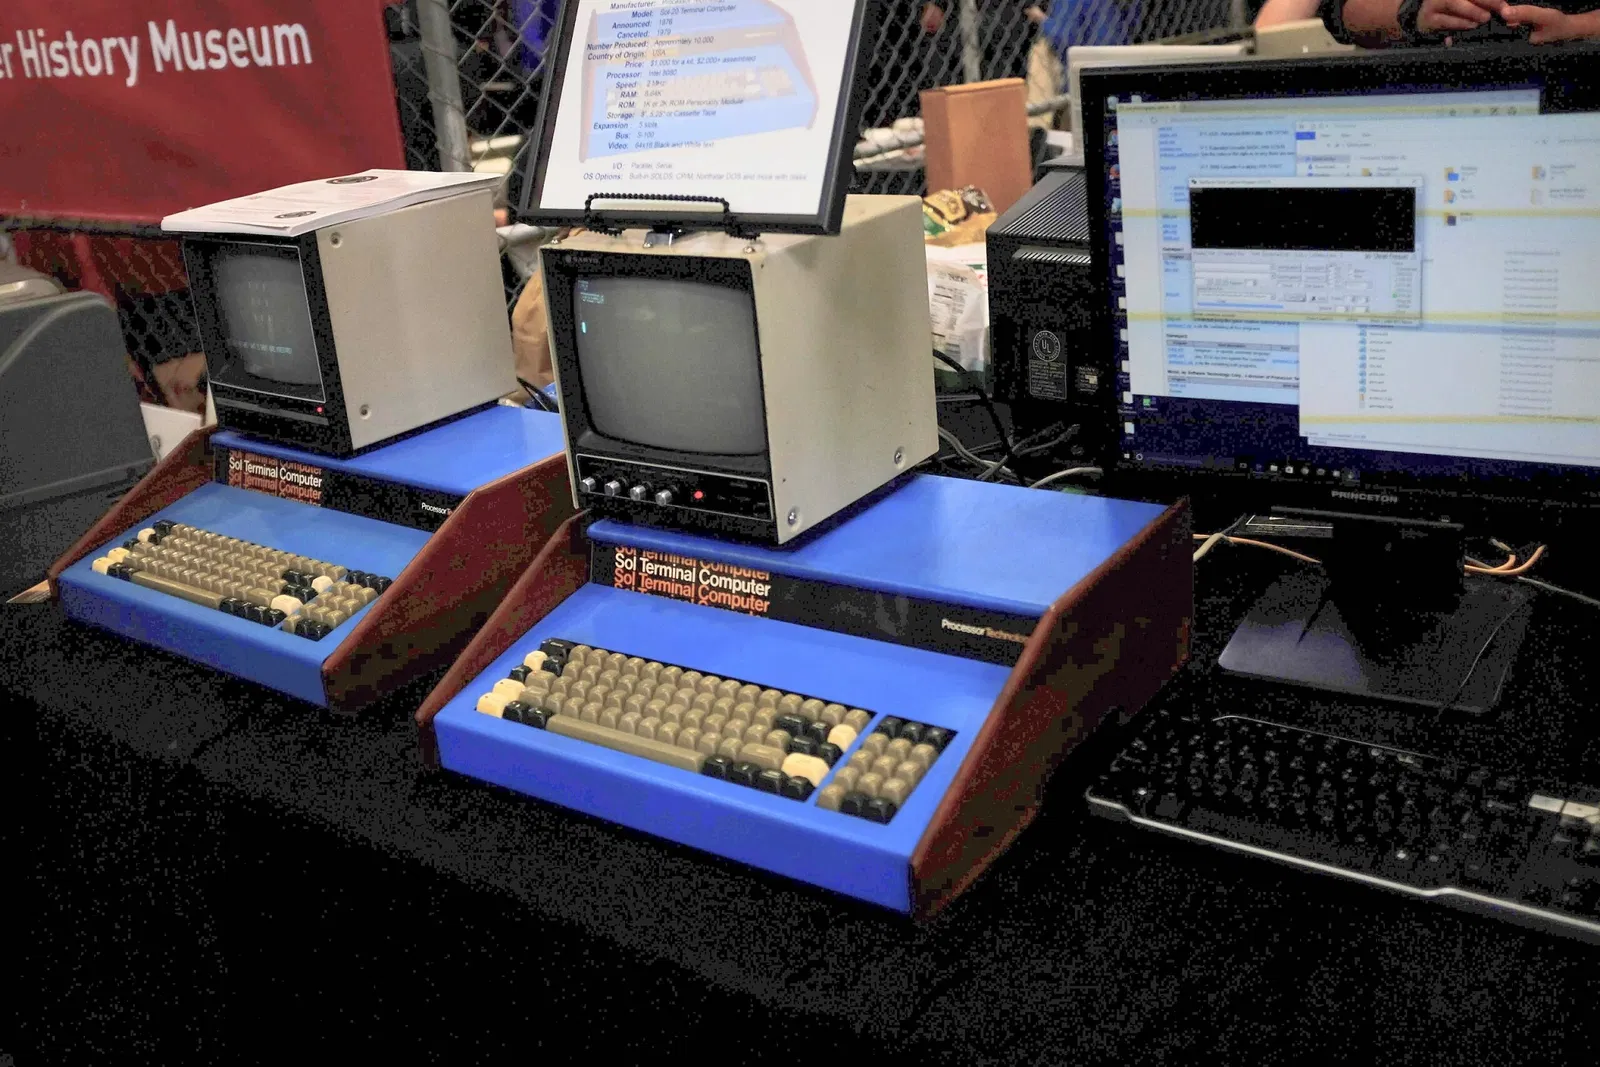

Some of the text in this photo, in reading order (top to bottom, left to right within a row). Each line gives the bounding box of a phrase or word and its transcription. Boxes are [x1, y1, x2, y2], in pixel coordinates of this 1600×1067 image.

[631, 10, 654, 19] Model:
[706, 4, 737, 12] Computer
[612, 20, 652, 30] Announced:
[616, 31, 650, 40] Canceled:
[586, 43, 613, 51] Number
[613, 40, 649, 49] Produced:
[16, 28, 139, 88] History
[147, 19, 313, 73] Museum
[587, 51, 614, 62] Country
[617, 51, 626, 60] of
[652, 49, 667, 58] USA
[624, 61, 645, 69] Price:
[606, 71, 643, 80] Processor:
[606, 111, 636, 121] Storage:
[673, 108, 700, 116] Cassette
[702, 107, 717, 117] Tape
[615, 132, 632, 140] Bus:
[608, 142, 629, 150] Video:
[583, 173, 594, 181] OS
[594, 172, 624, 183] Options:
[228, 457, 323, 488] Sol Terminal Computer
[279, 480, 322, 500] Computer
[1331, 490, 1399, 503] PRINCETON
[421, 502, 447, 514] Processor
[614, 552, 772, 597] Sol Terminal Computer
[614, 567, 636, 586] Sol
[638, 572, 695, 598] Terminal
[697, 583, 771, 613] Computer
[941, 618, 986, 636] Processor
